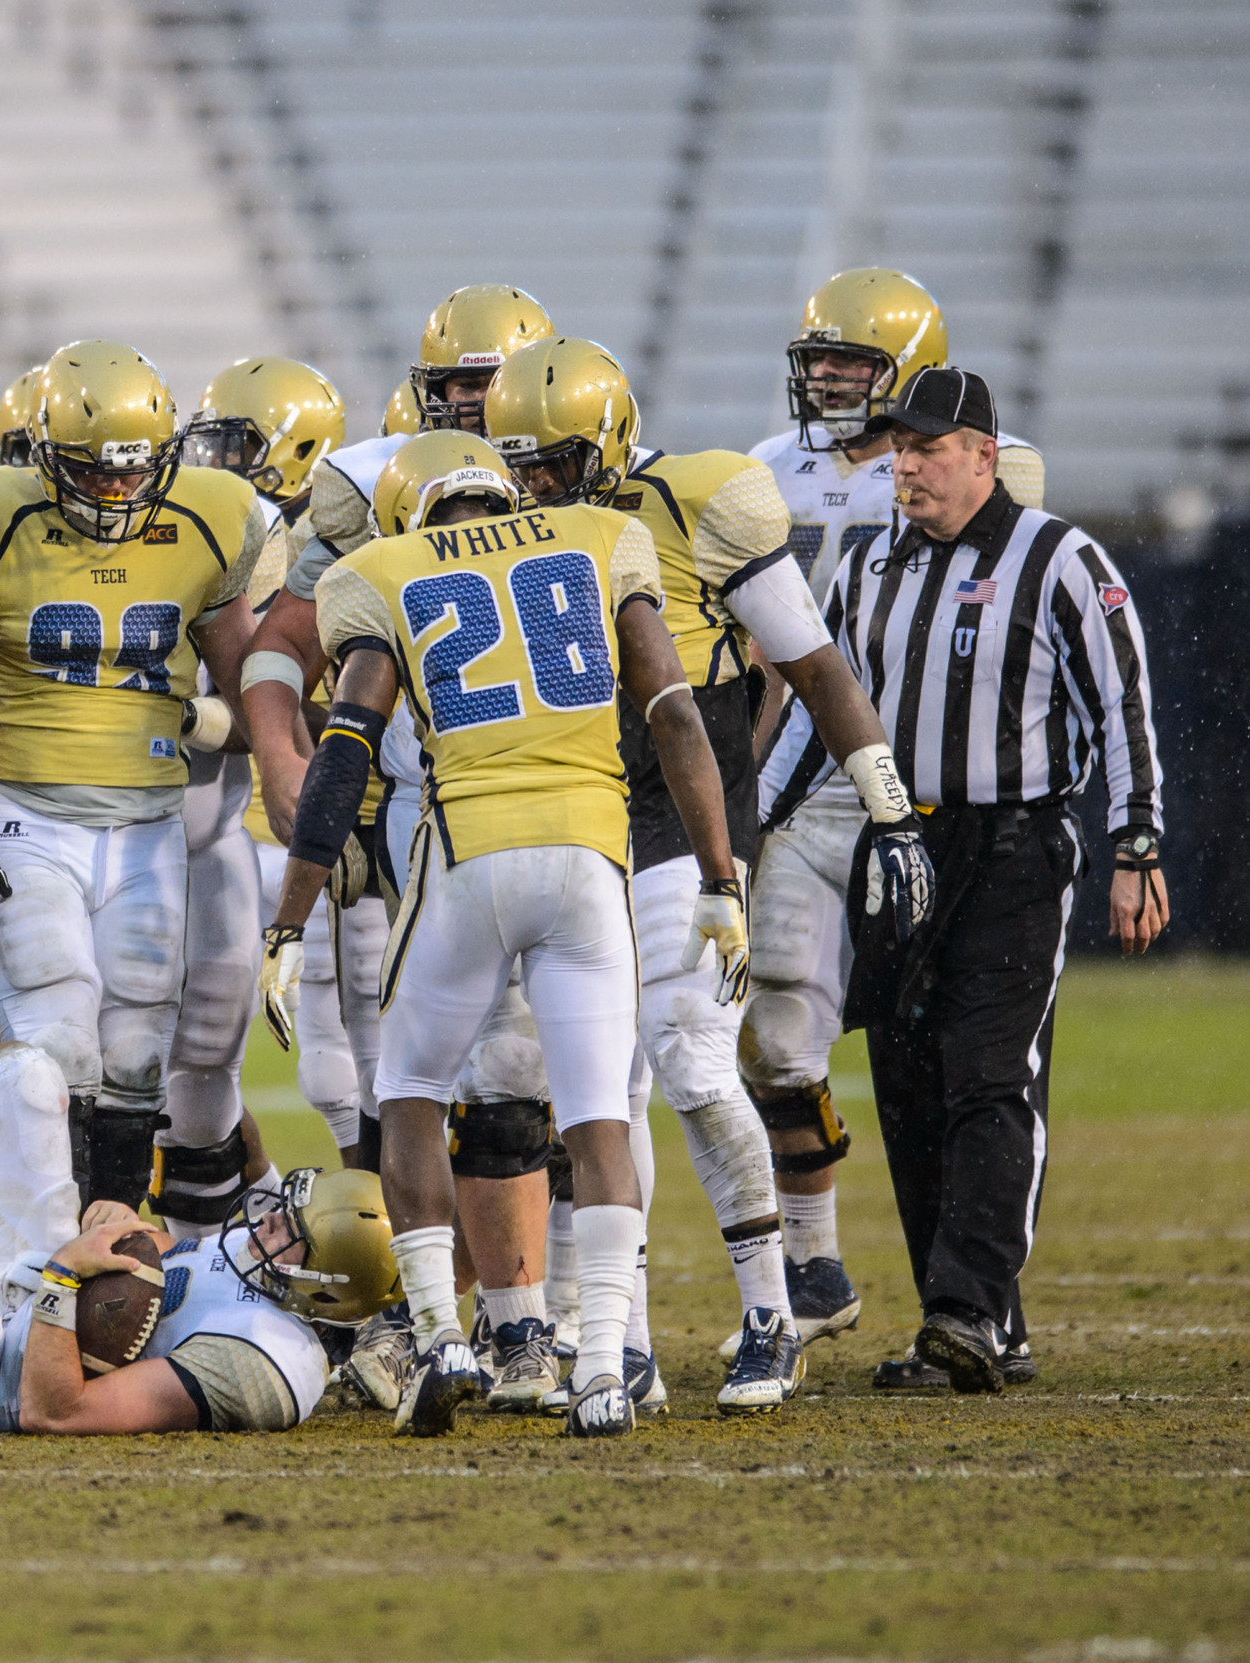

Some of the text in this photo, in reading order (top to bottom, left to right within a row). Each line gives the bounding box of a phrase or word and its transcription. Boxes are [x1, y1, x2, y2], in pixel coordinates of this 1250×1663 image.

[462, 356, 501, 366] Riddell
[876, 372, 894, 392] Ridd
[116, 444, 141, 454] ACC
[502, 438, 521, 450] ACC
[464, 455, 476, 465] 28
[584, 456, 600, 480] ddell
[455, 470, 495, 482] JACKETS
[823, 493, 849, 507] TECH
[46, 528, 64, 541] R
[145, 527, 176, 541] ACC
[424, 513, 556, 562] WHITE
[90, 569, 128, 584] TECH
[399, 550, 618, 739] 28
[955, 627, 976, 658] U
[3, 821, 21, 834] R
[40, 1293, 60, 1308] R
